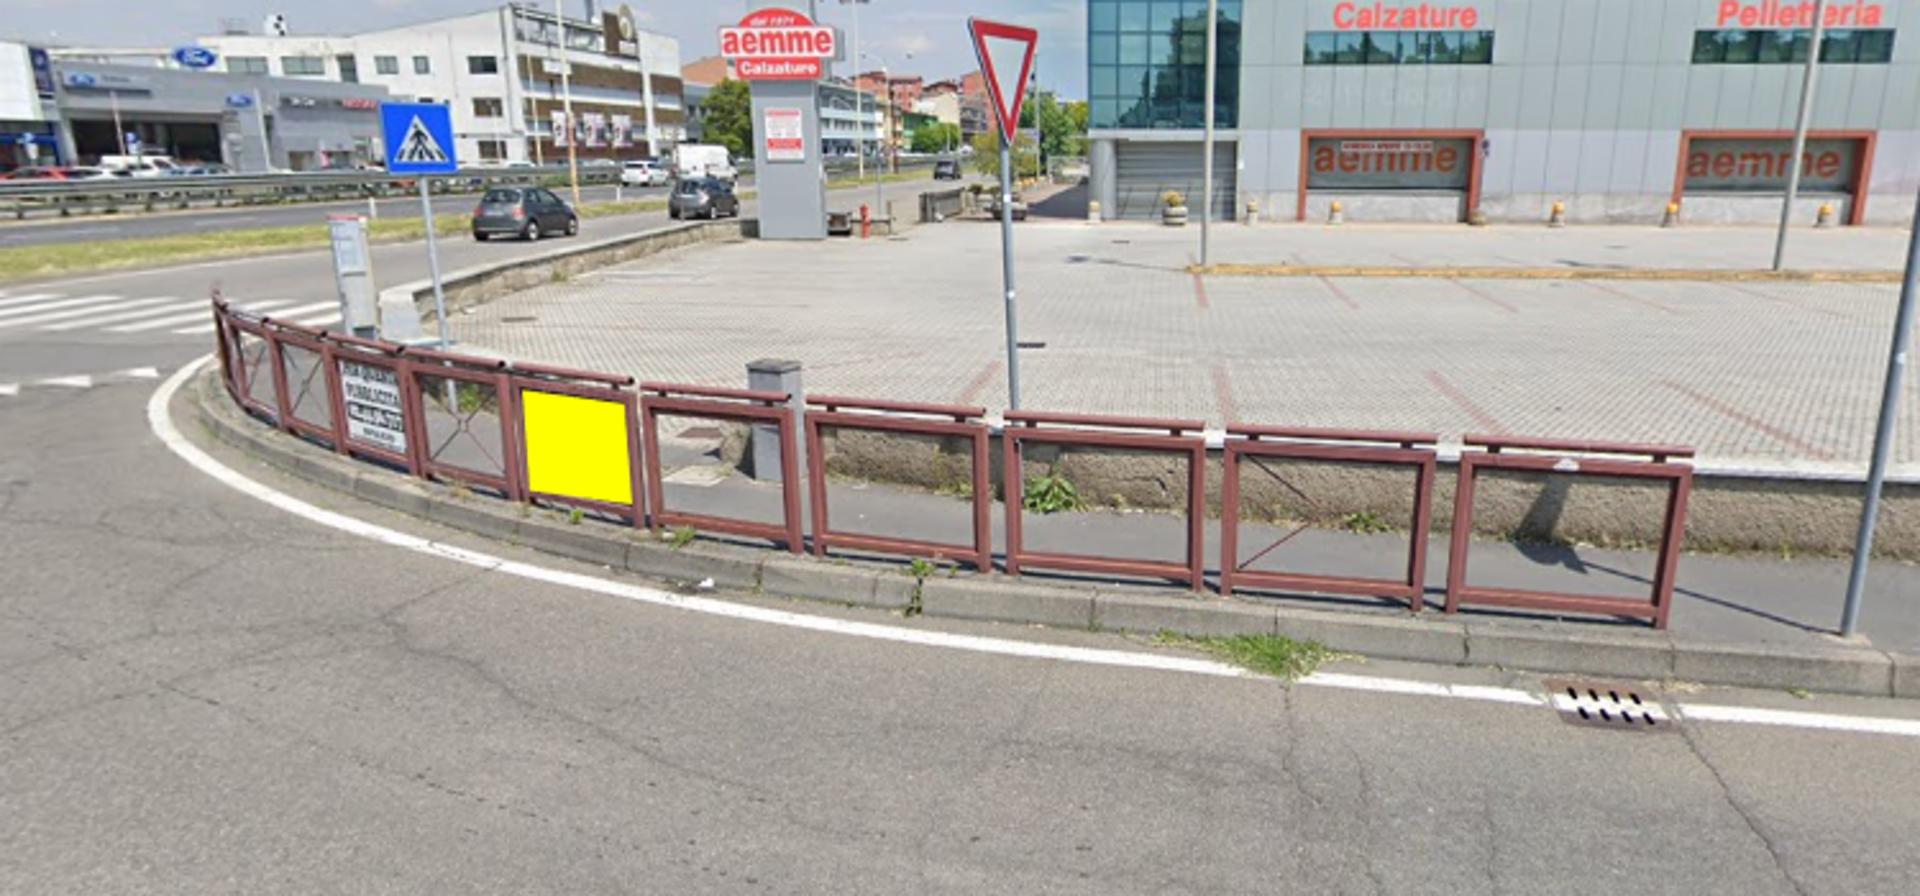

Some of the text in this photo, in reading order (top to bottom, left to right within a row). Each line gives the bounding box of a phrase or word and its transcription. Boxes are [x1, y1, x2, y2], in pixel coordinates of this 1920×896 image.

[1333, 2, 1476, 29] Calzature
[1716, 0, 1882, 27] Pelleteria
[722, 31, 832, 53] aemme
[741, 61, 817, 75] Calzature
[1314, 144, 1457, 173] aemme
